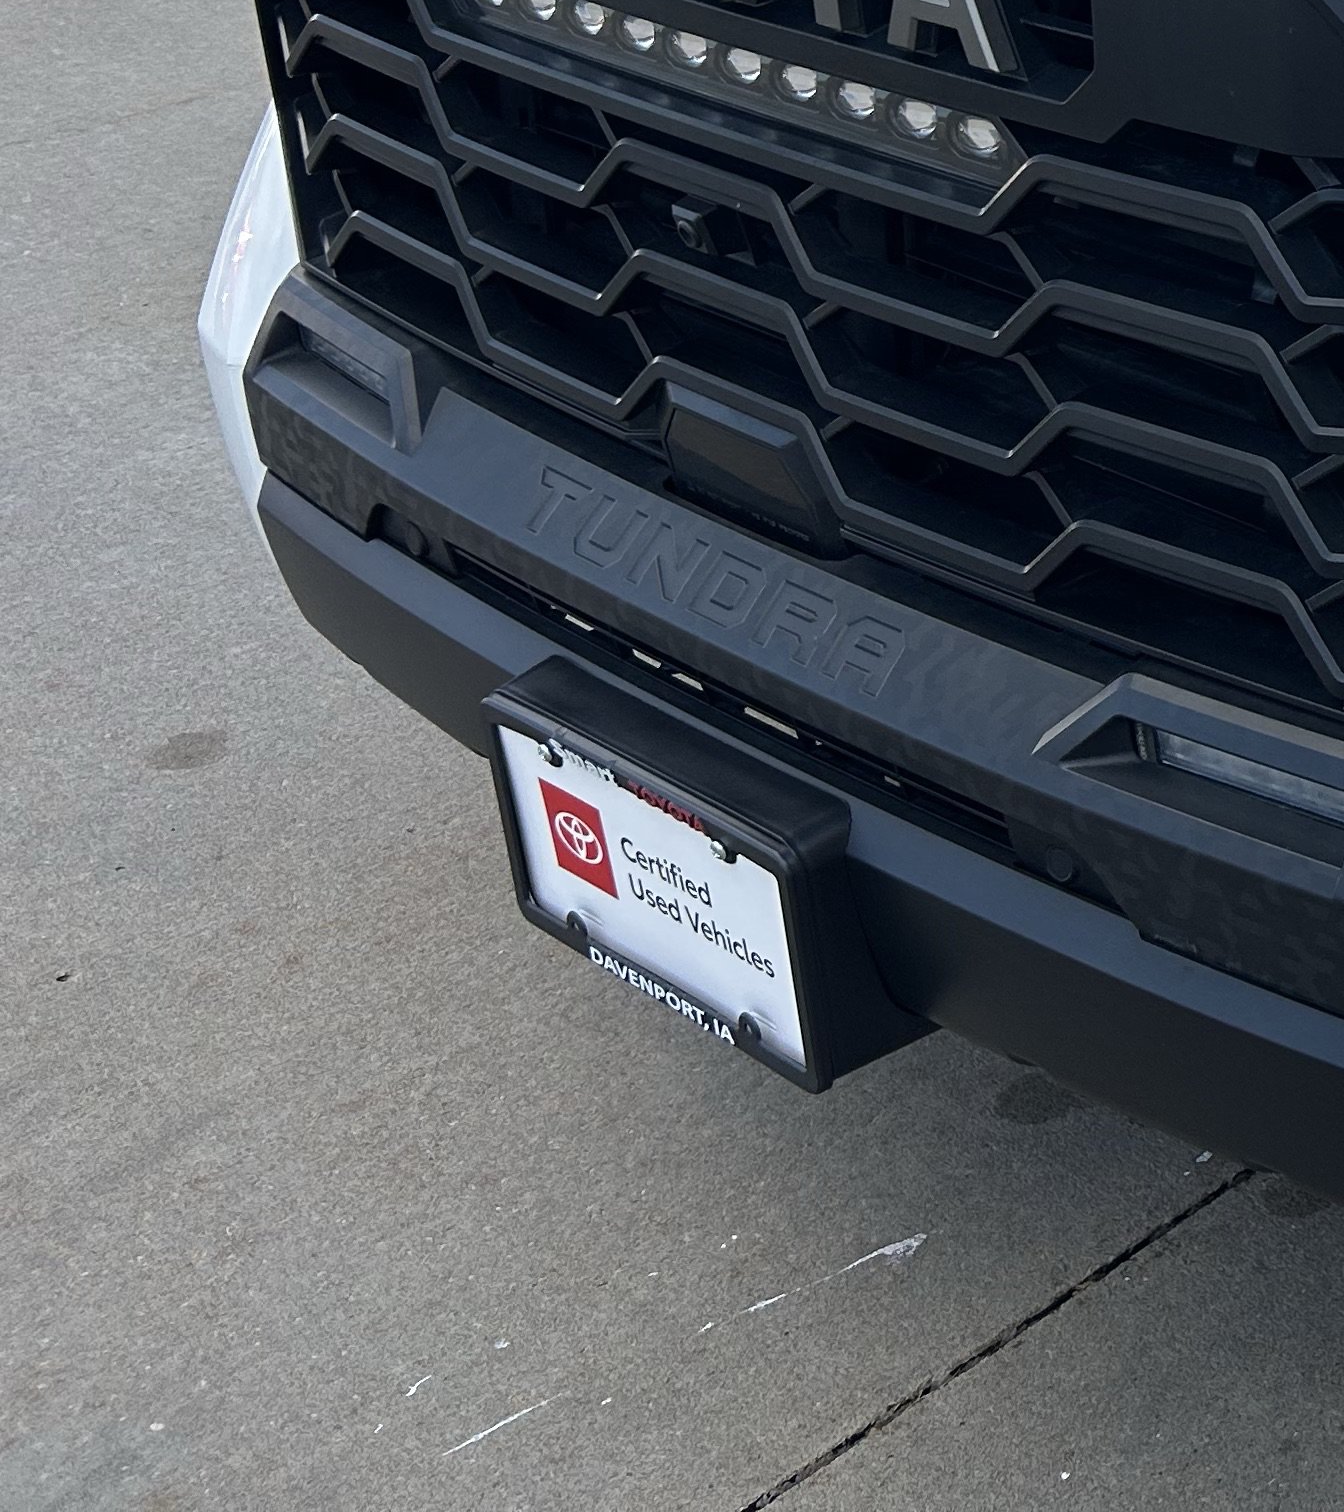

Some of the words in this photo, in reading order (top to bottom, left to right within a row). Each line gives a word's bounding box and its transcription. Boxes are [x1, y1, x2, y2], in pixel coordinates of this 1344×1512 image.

[526, 464, 907, 700] TUNDRA
[548, 737, 616, 783] Smart
[621, 836, 714, 908] Certified
[628, 872, 682, 925] Used
[688, 905, 777, 979] Vehicles
[588, 944, 711, 1032] DAVENPORT,
[712, 1017, 738, 1046] IA
